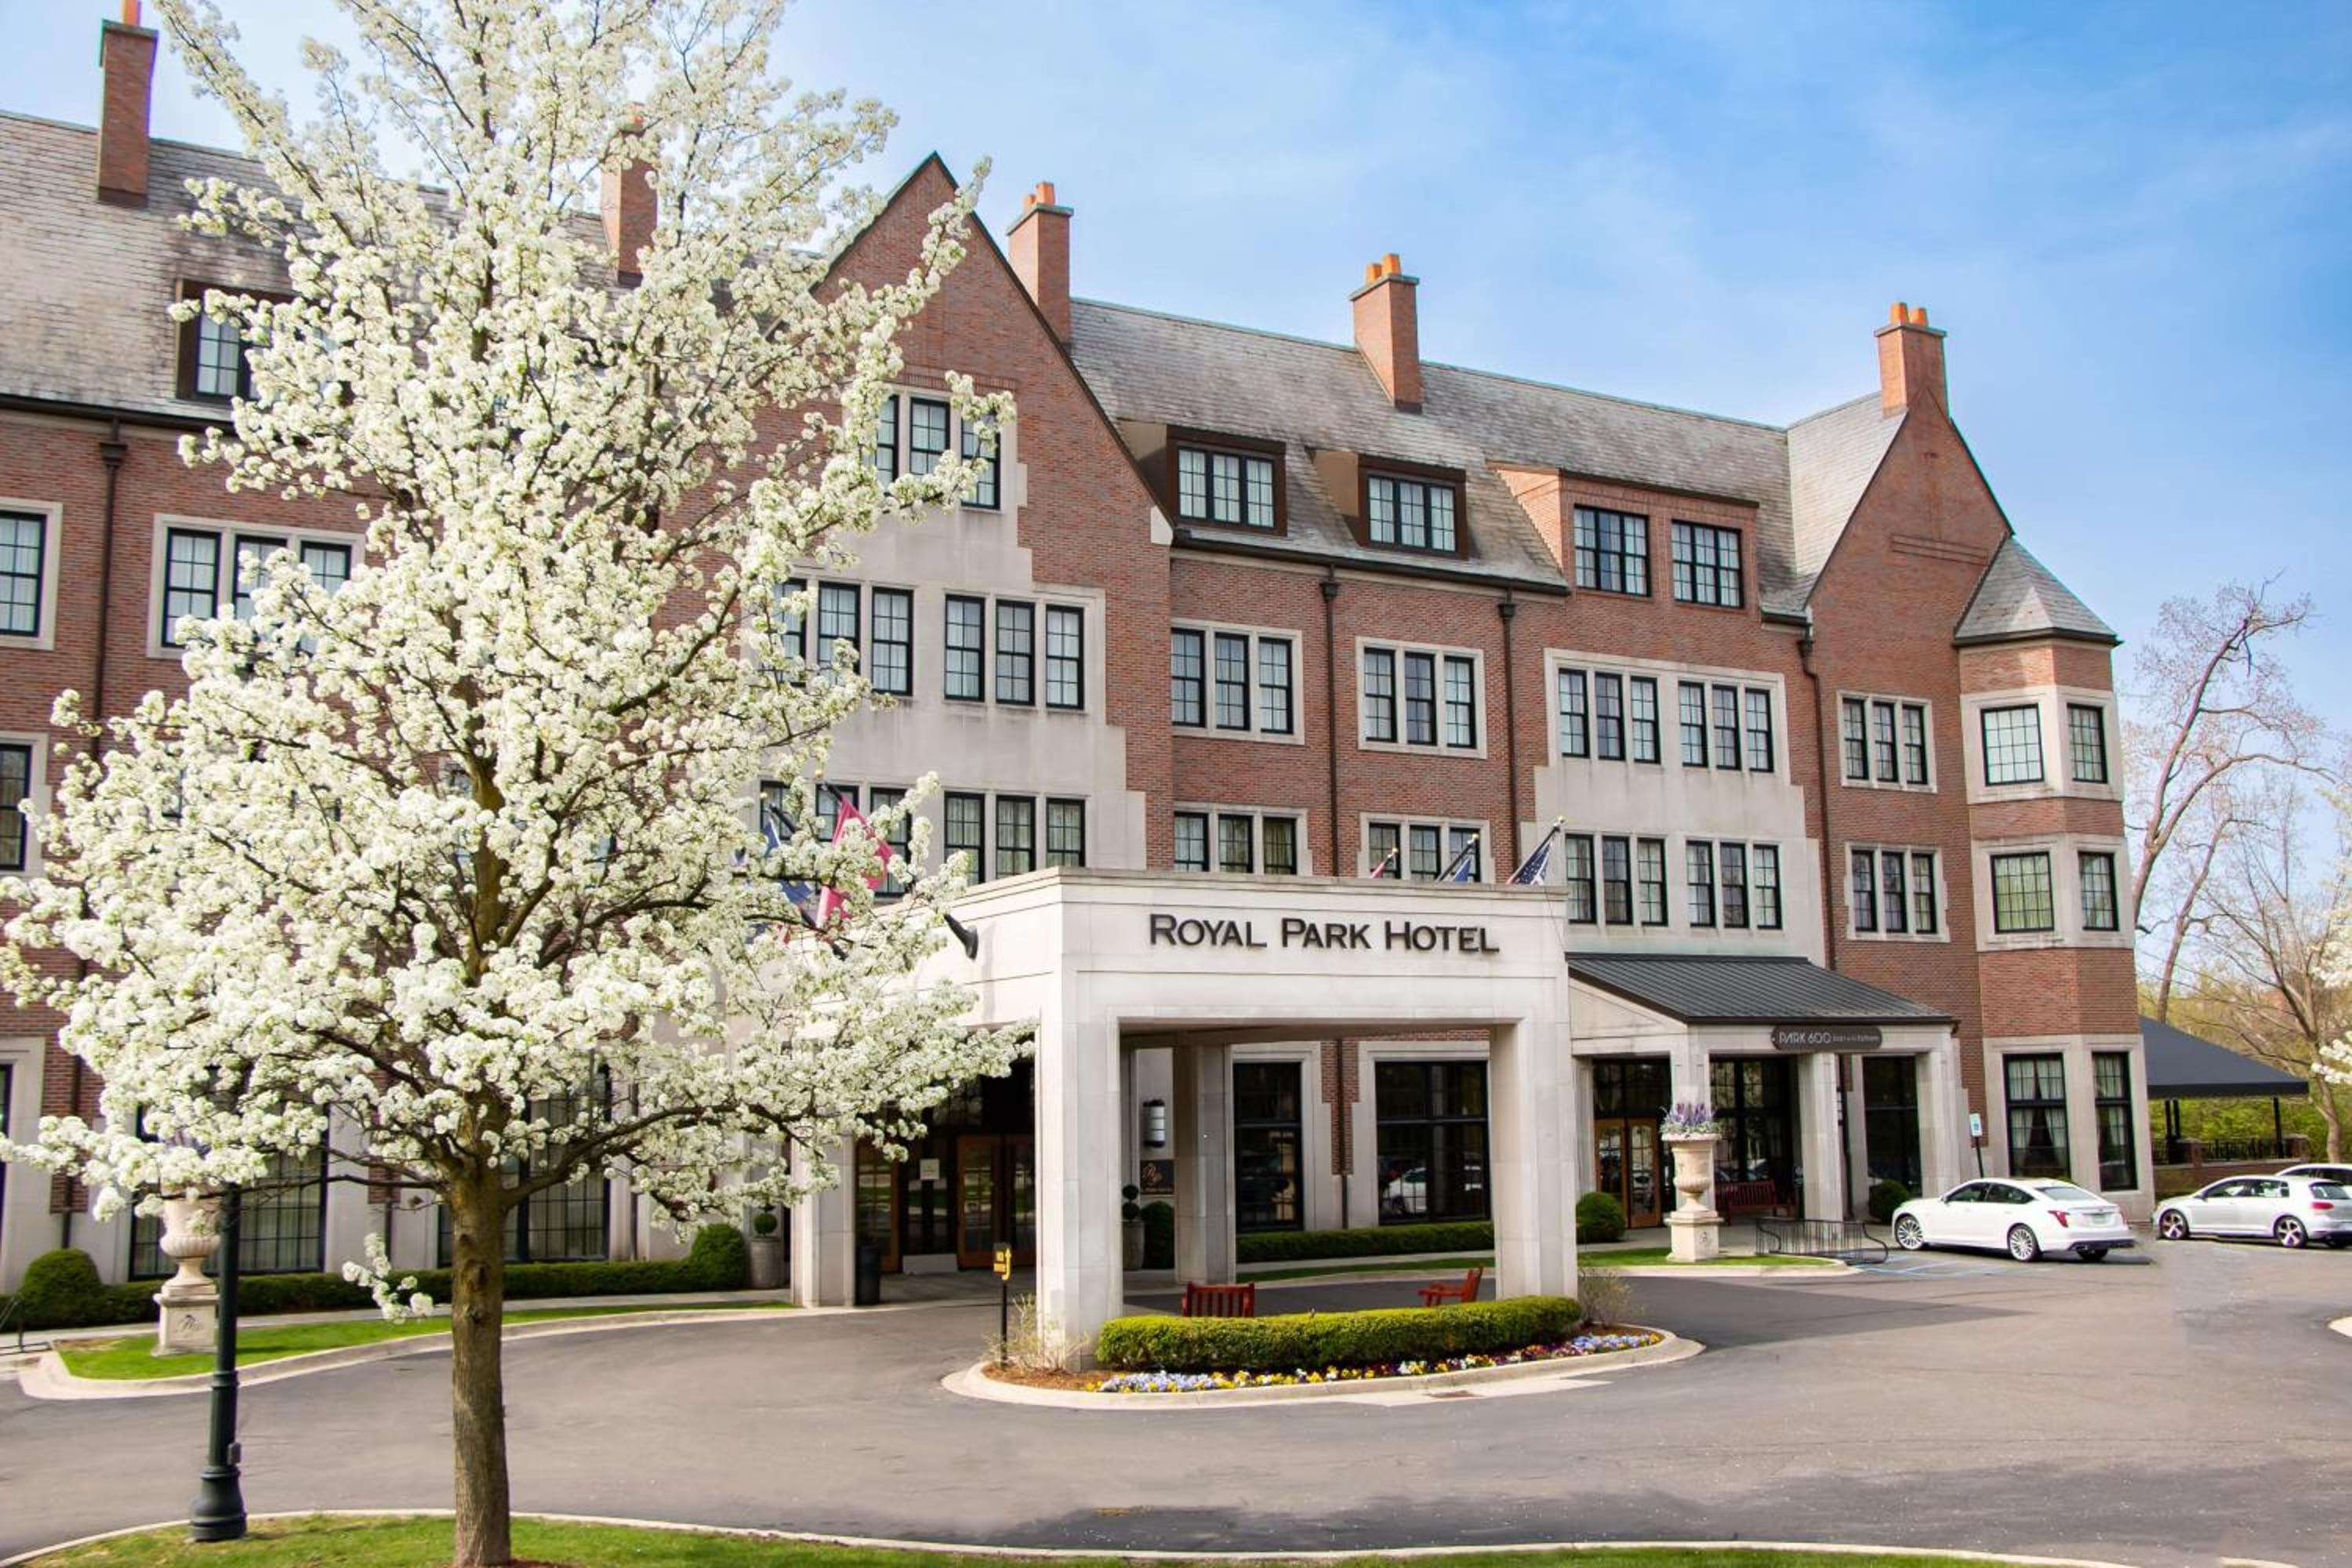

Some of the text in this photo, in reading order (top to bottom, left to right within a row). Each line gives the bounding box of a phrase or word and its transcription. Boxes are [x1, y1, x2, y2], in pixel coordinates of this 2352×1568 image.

[1149, 913, 1500, 954] ROYAL PARK HOTEL
[1779, 1031, 1806, 1044] PARK
[1807, 1032, 1831, 1044] 600
